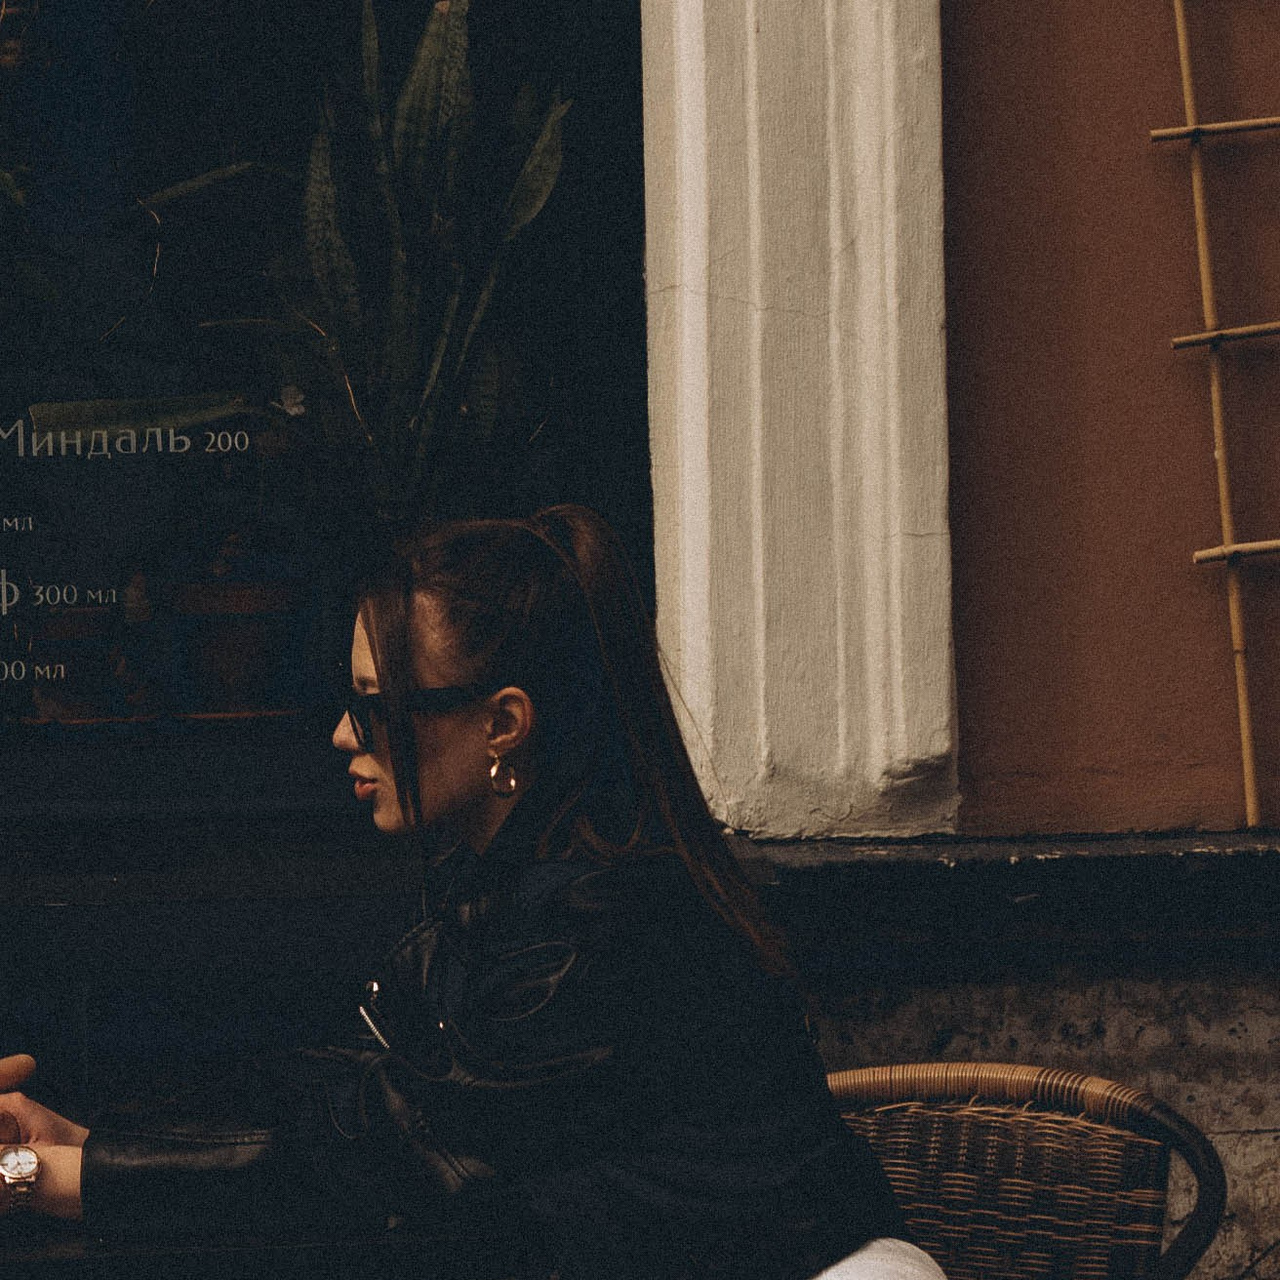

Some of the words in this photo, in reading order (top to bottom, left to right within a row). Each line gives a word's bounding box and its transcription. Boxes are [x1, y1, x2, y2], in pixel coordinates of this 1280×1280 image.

[204, 431, 250, 453] 200
[3, 516, 34, 532] мл
[33, 584, 78, 606] 300
[86, 588, 117, 604] мл
[34, 663, 66, 680] мл
